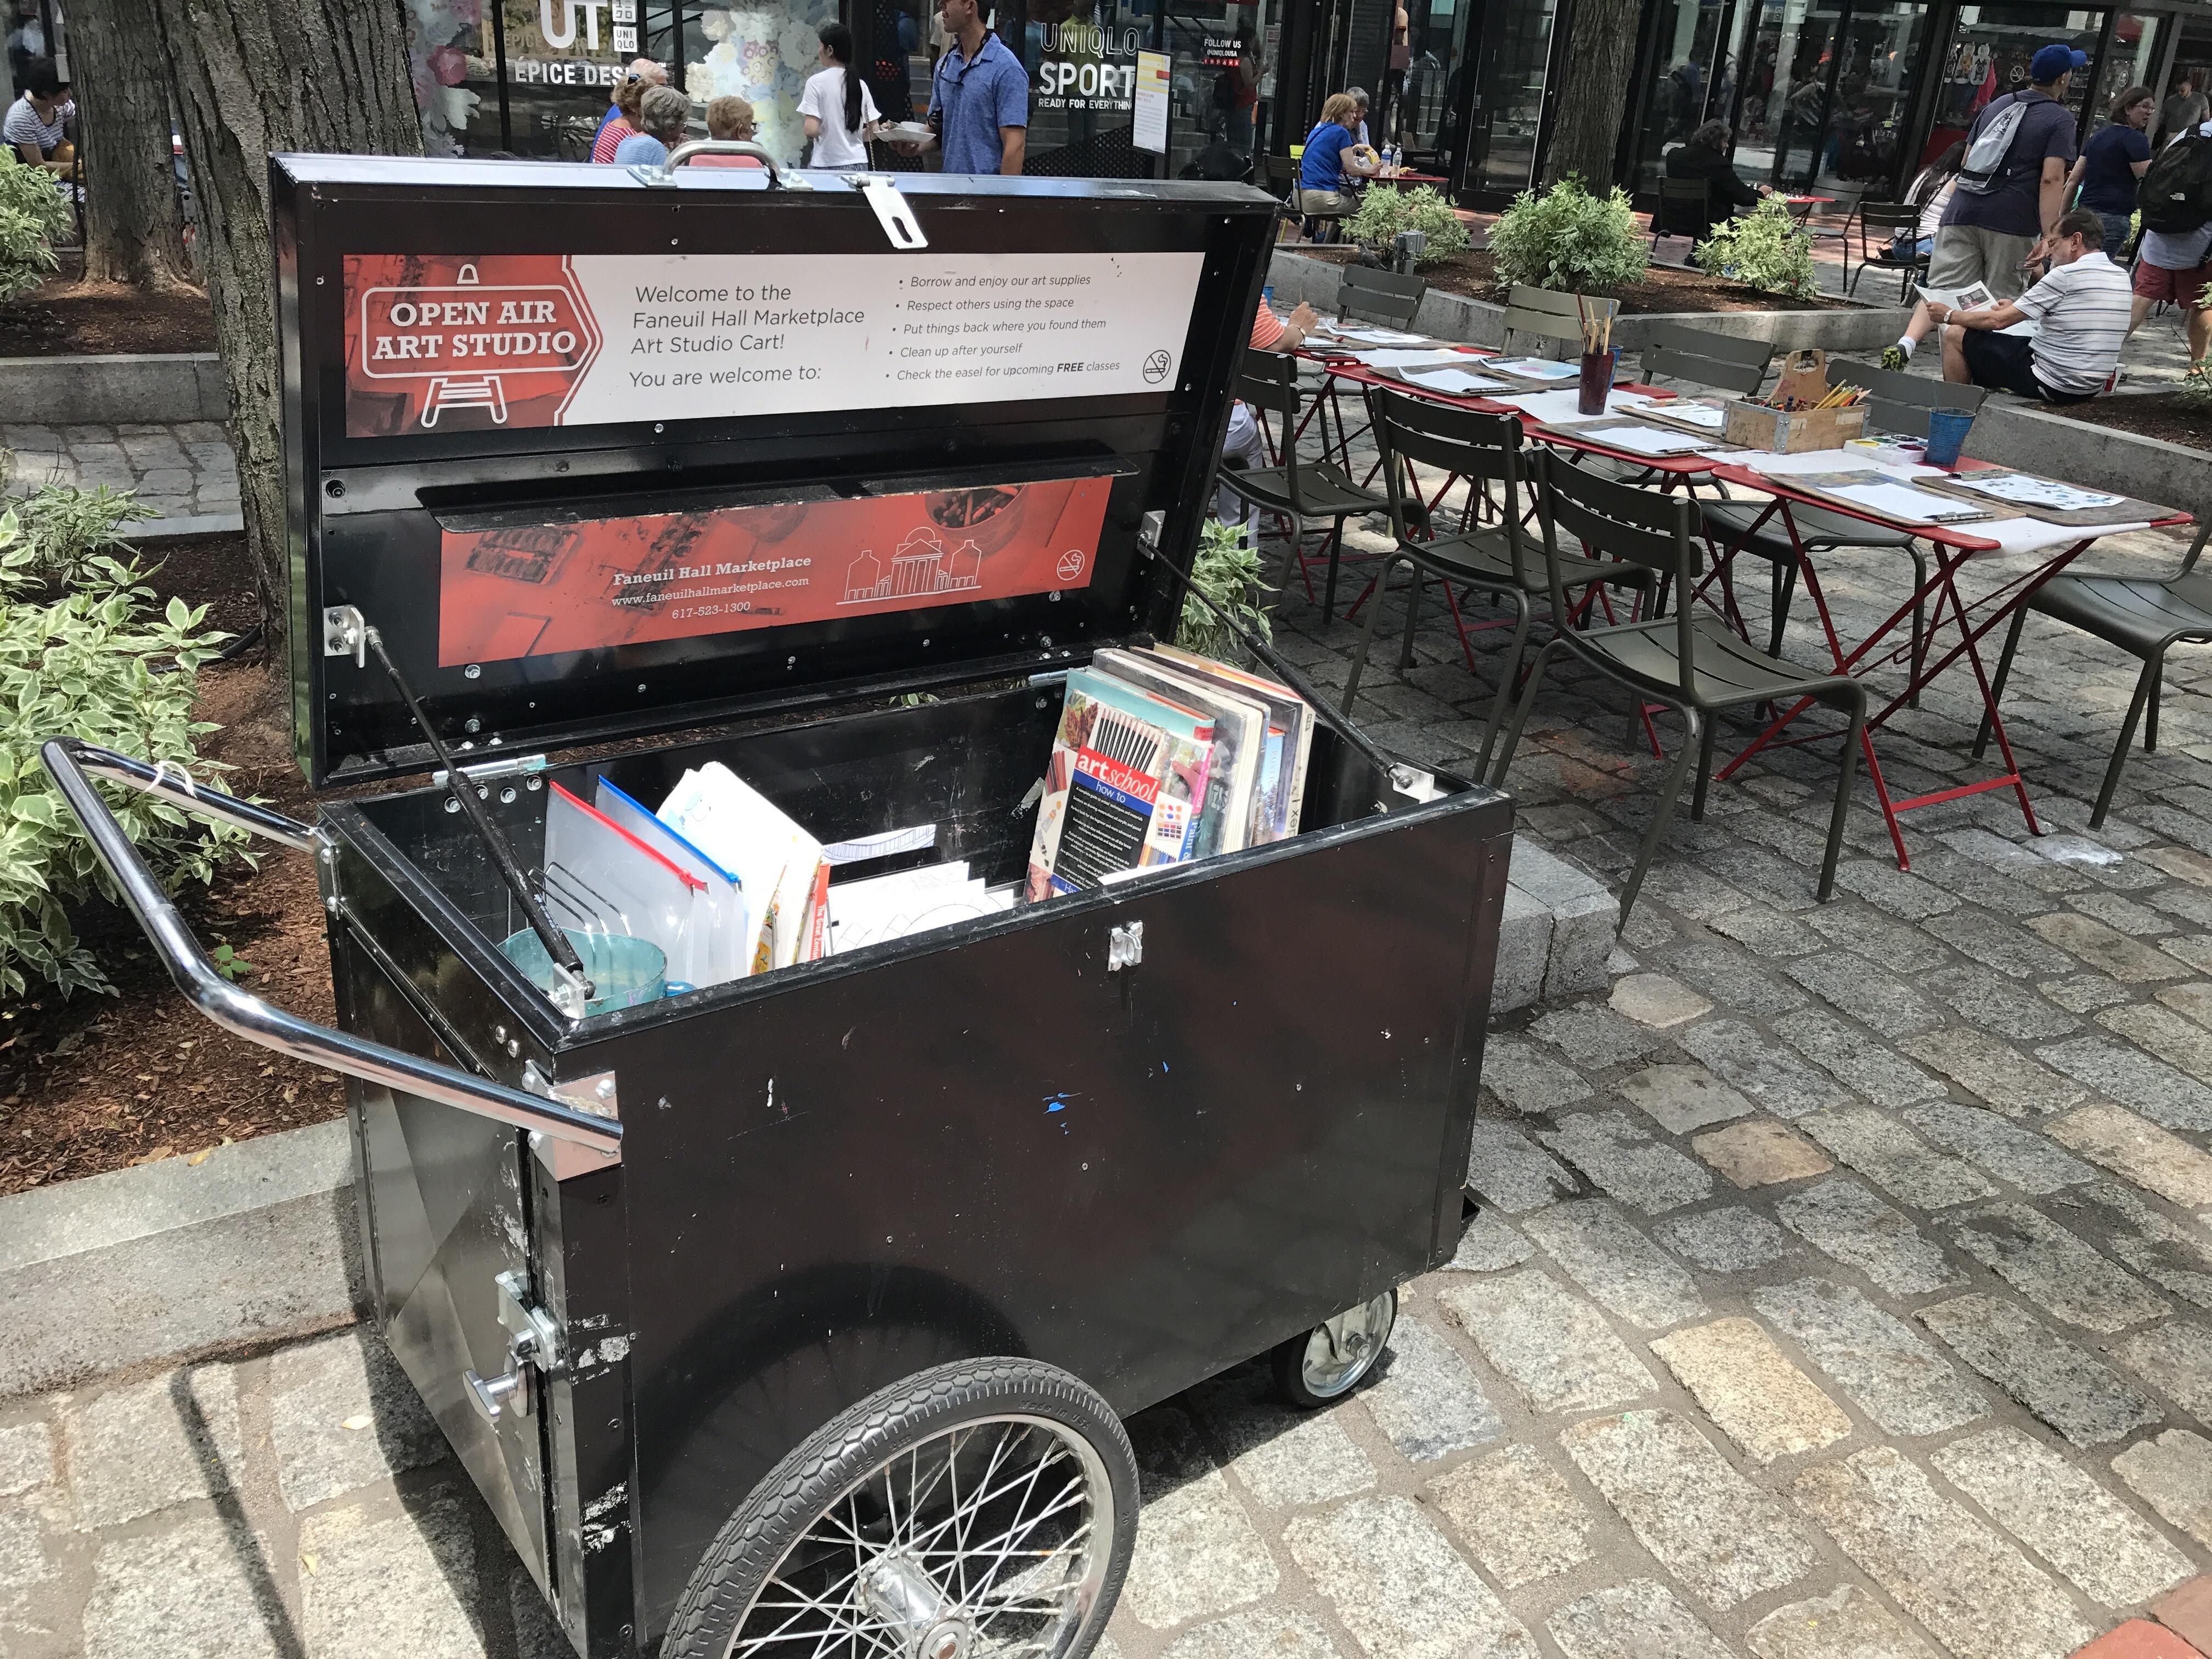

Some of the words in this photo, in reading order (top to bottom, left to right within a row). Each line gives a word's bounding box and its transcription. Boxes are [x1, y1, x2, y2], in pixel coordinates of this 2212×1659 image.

[539, 0, 607, 50] UT
[617, 30, 632, 38] UNI
[617, 40, 634, 49] QLO
[1041, 23, 1139, 58] UNIQLO
[1204, 39, 1231, 48] FOLLOW
[584, 65, 629, 86] DES
[1039, 61, 1135, 98] SPORT
[1039, 98, 1066, 108] READY
[1069, 99, 1086, 109] FOR
[911, 276, 952, 287] Borrow
[955, 276, 976, 286] and
[979, 276, 1008, 287] enjoy
[1032, 276, 1046, 285] art
[1049, 275, 1091, 286] supplies
[636, 285, 728, 302] Welcome
[736, 286, 754, 301] to
[761, 284, 791, 300] the
[391, 302, 489, 326] OPEN
[497, 301, 556, 324] AIR
[907, 301, 952, 312] Respect
[956, 300, 990, 309] others
[994, 299, 1022, 310] using
[1025, 298, 1041, 308] the
[1045, 300, 1074, 309] space
[634, 311, 704, 328] Faneuil
[712, 309, 747, 326] Hall
[754, 308, 864, 327] Marketplace
[904, 324, 923, 334] Put
[927, 323, 960, 335] things
[963, 322, 989, 332] back
[993, 321, 1024, 331] where
[1027, 323, 1046, 332] you
[1049, 319, 1079, 329] found
[1081, 319, 1106, 329] them
[372, 335, 442, 359] ART
[453, 331, 575, 357] STUDIO
[631, 338, 663, 354] Art
[670, 336, 732, 352] Studio
[740, 334, 784, 350] Cart!
[901, 347, 931, 357] Clean
[935, 348, 949, 358] up
[952, 345, 978, 356] after
[980, 343, 1023, 356] yourself
[629, 372, 665, 387] You
[673, 373, 702, 385] are
[710, 367, 792, 383] welcome
[799, 366, 821, 380] to:
[898, 369, 932, 380] Check
[935, 369, 952, 379] the
[956, 366, 982, 377] easel
[986, 366, 1001, 376] for
[1003, 366, 1053, 377] upcoming
[1057, 362, 1084, 373] FREE
[1087, 361, 1120, 371] classes
[613, 569, 674, 585] Faneuil
[679, 565, 711, 578] Hall
[715, 557, 811, 575] Marketplace
[611, 576, 809, 606] www.faneuilhallmarketplace.com
[672, 601, 750, 619] 617-523-1300
[1096, 781, 1115, 798] how
[1117, 792, 1125, 803] to
[815, 918, 823, 936] Great
[1018, 1401, 1052, 1412] Made
[1071, 1413, 1092, 1431] USA
[716, 1528, 796, 1641] WORKSMAN
[808, 1455, 876, 1515] CYCLES
